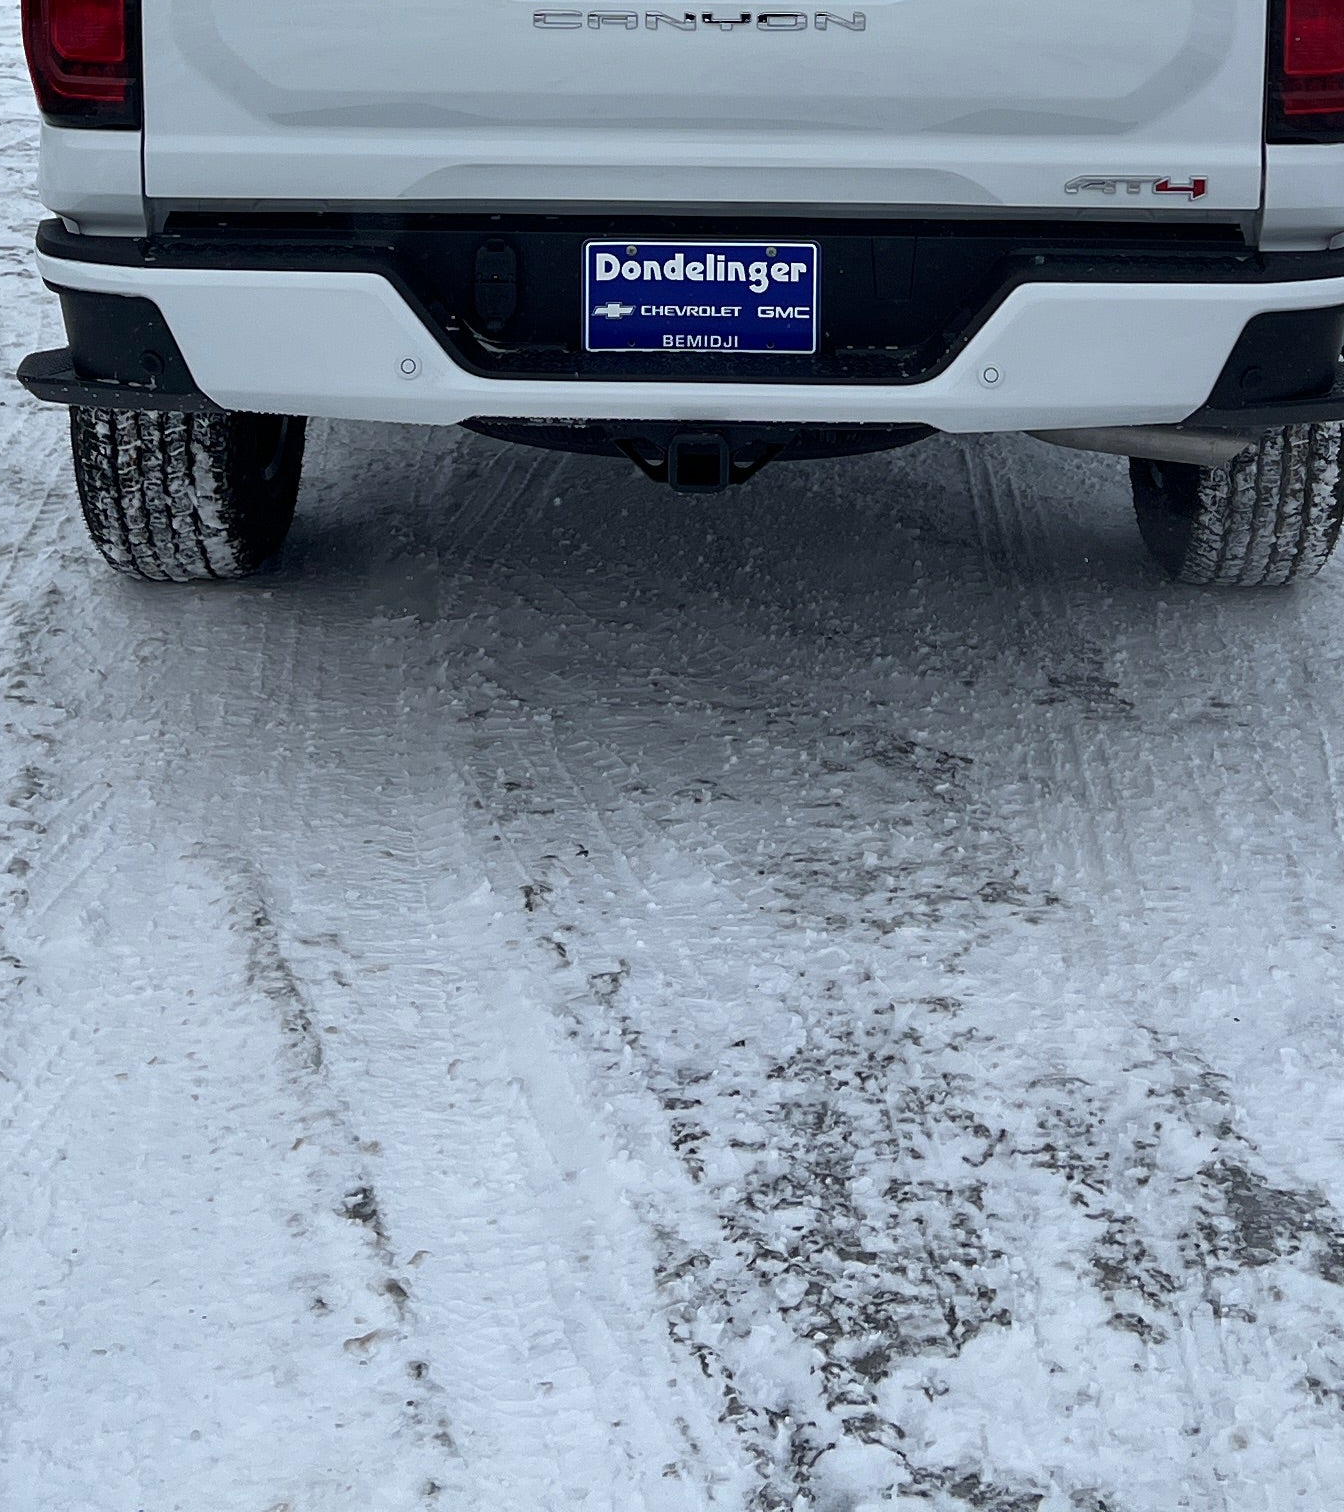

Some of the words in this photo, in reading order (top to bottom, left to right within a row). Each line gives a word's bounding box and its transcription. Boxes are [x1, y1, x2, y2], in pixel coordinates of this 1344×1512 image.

[533, 9, 866, 32] CANYON
[1064, 175, 1208, 202] AT4
[596, 253, 807, 293] Dondelinger
[640, 305, 742, 317] CHEVROLET
[757, 306, 810, 319] GMC
[662, 334, 738, 348] BEMIDJI
